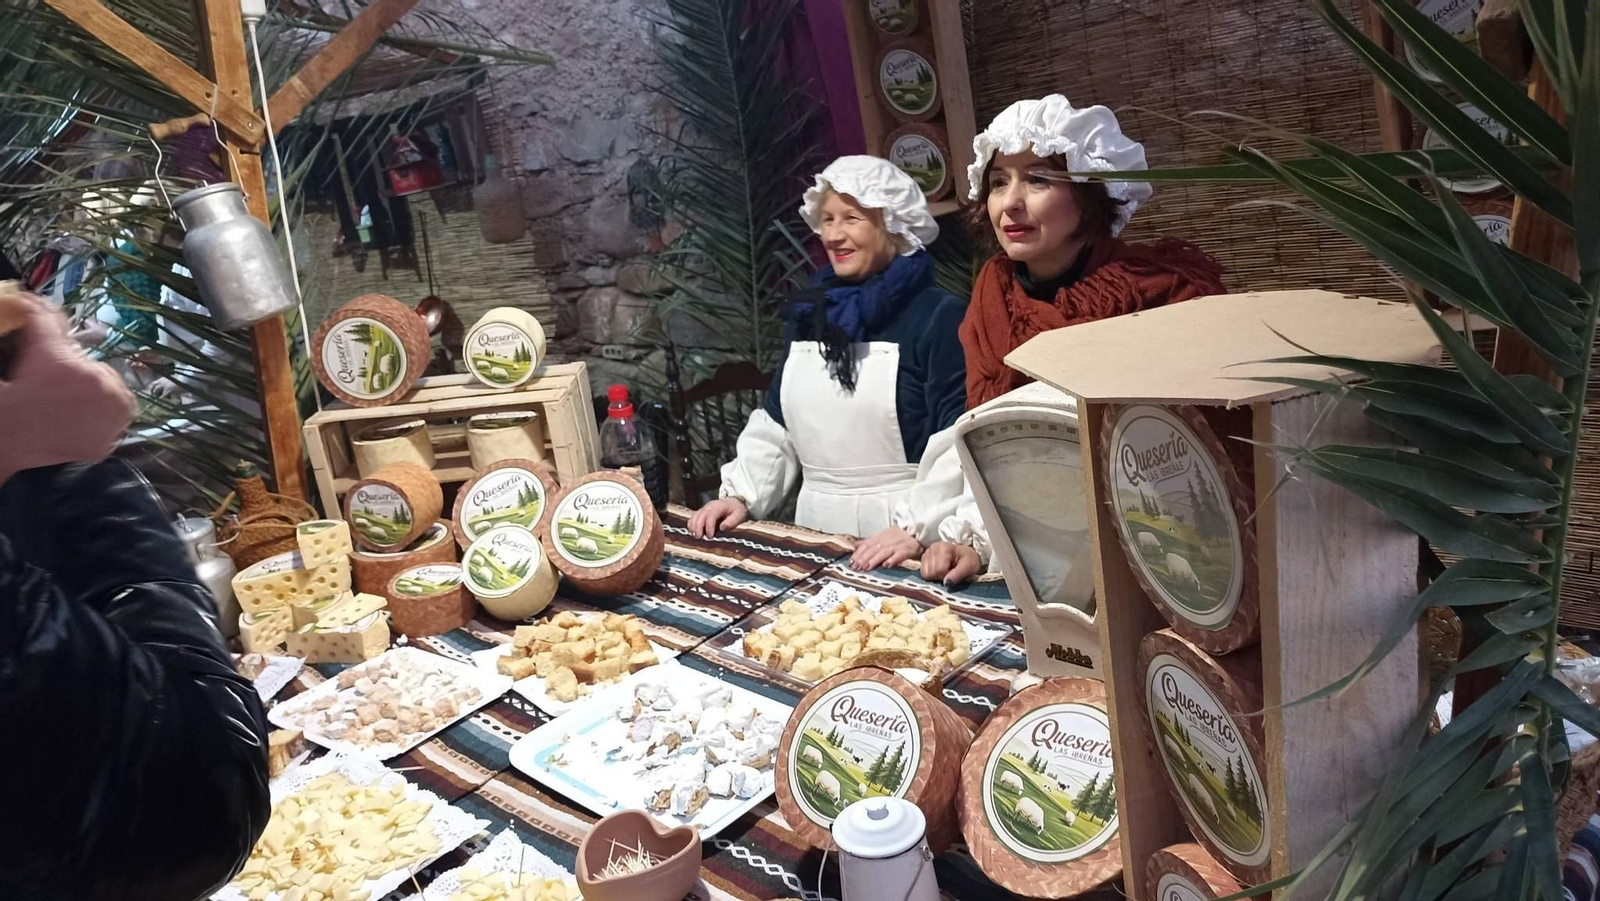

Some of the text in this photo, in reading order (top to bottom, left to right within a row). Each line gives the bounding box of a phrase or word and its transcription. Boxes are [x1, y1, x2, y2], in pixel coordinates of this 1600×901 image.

[1121, 431, 1188, 487] Quesería
[1146, 470, 1159, 482] LAS
[473, 474, 521, 506] Quesería
[574, 492, 629, 510] Quesería
[830, 694, 908, 734] Quesería
[1161, 671, 1236, 744] Quesería
[849, 721, 863, 730] LAS
[1184, 711, 1197, 726] LAS
[1053, 746, 1069, 755] LAS
